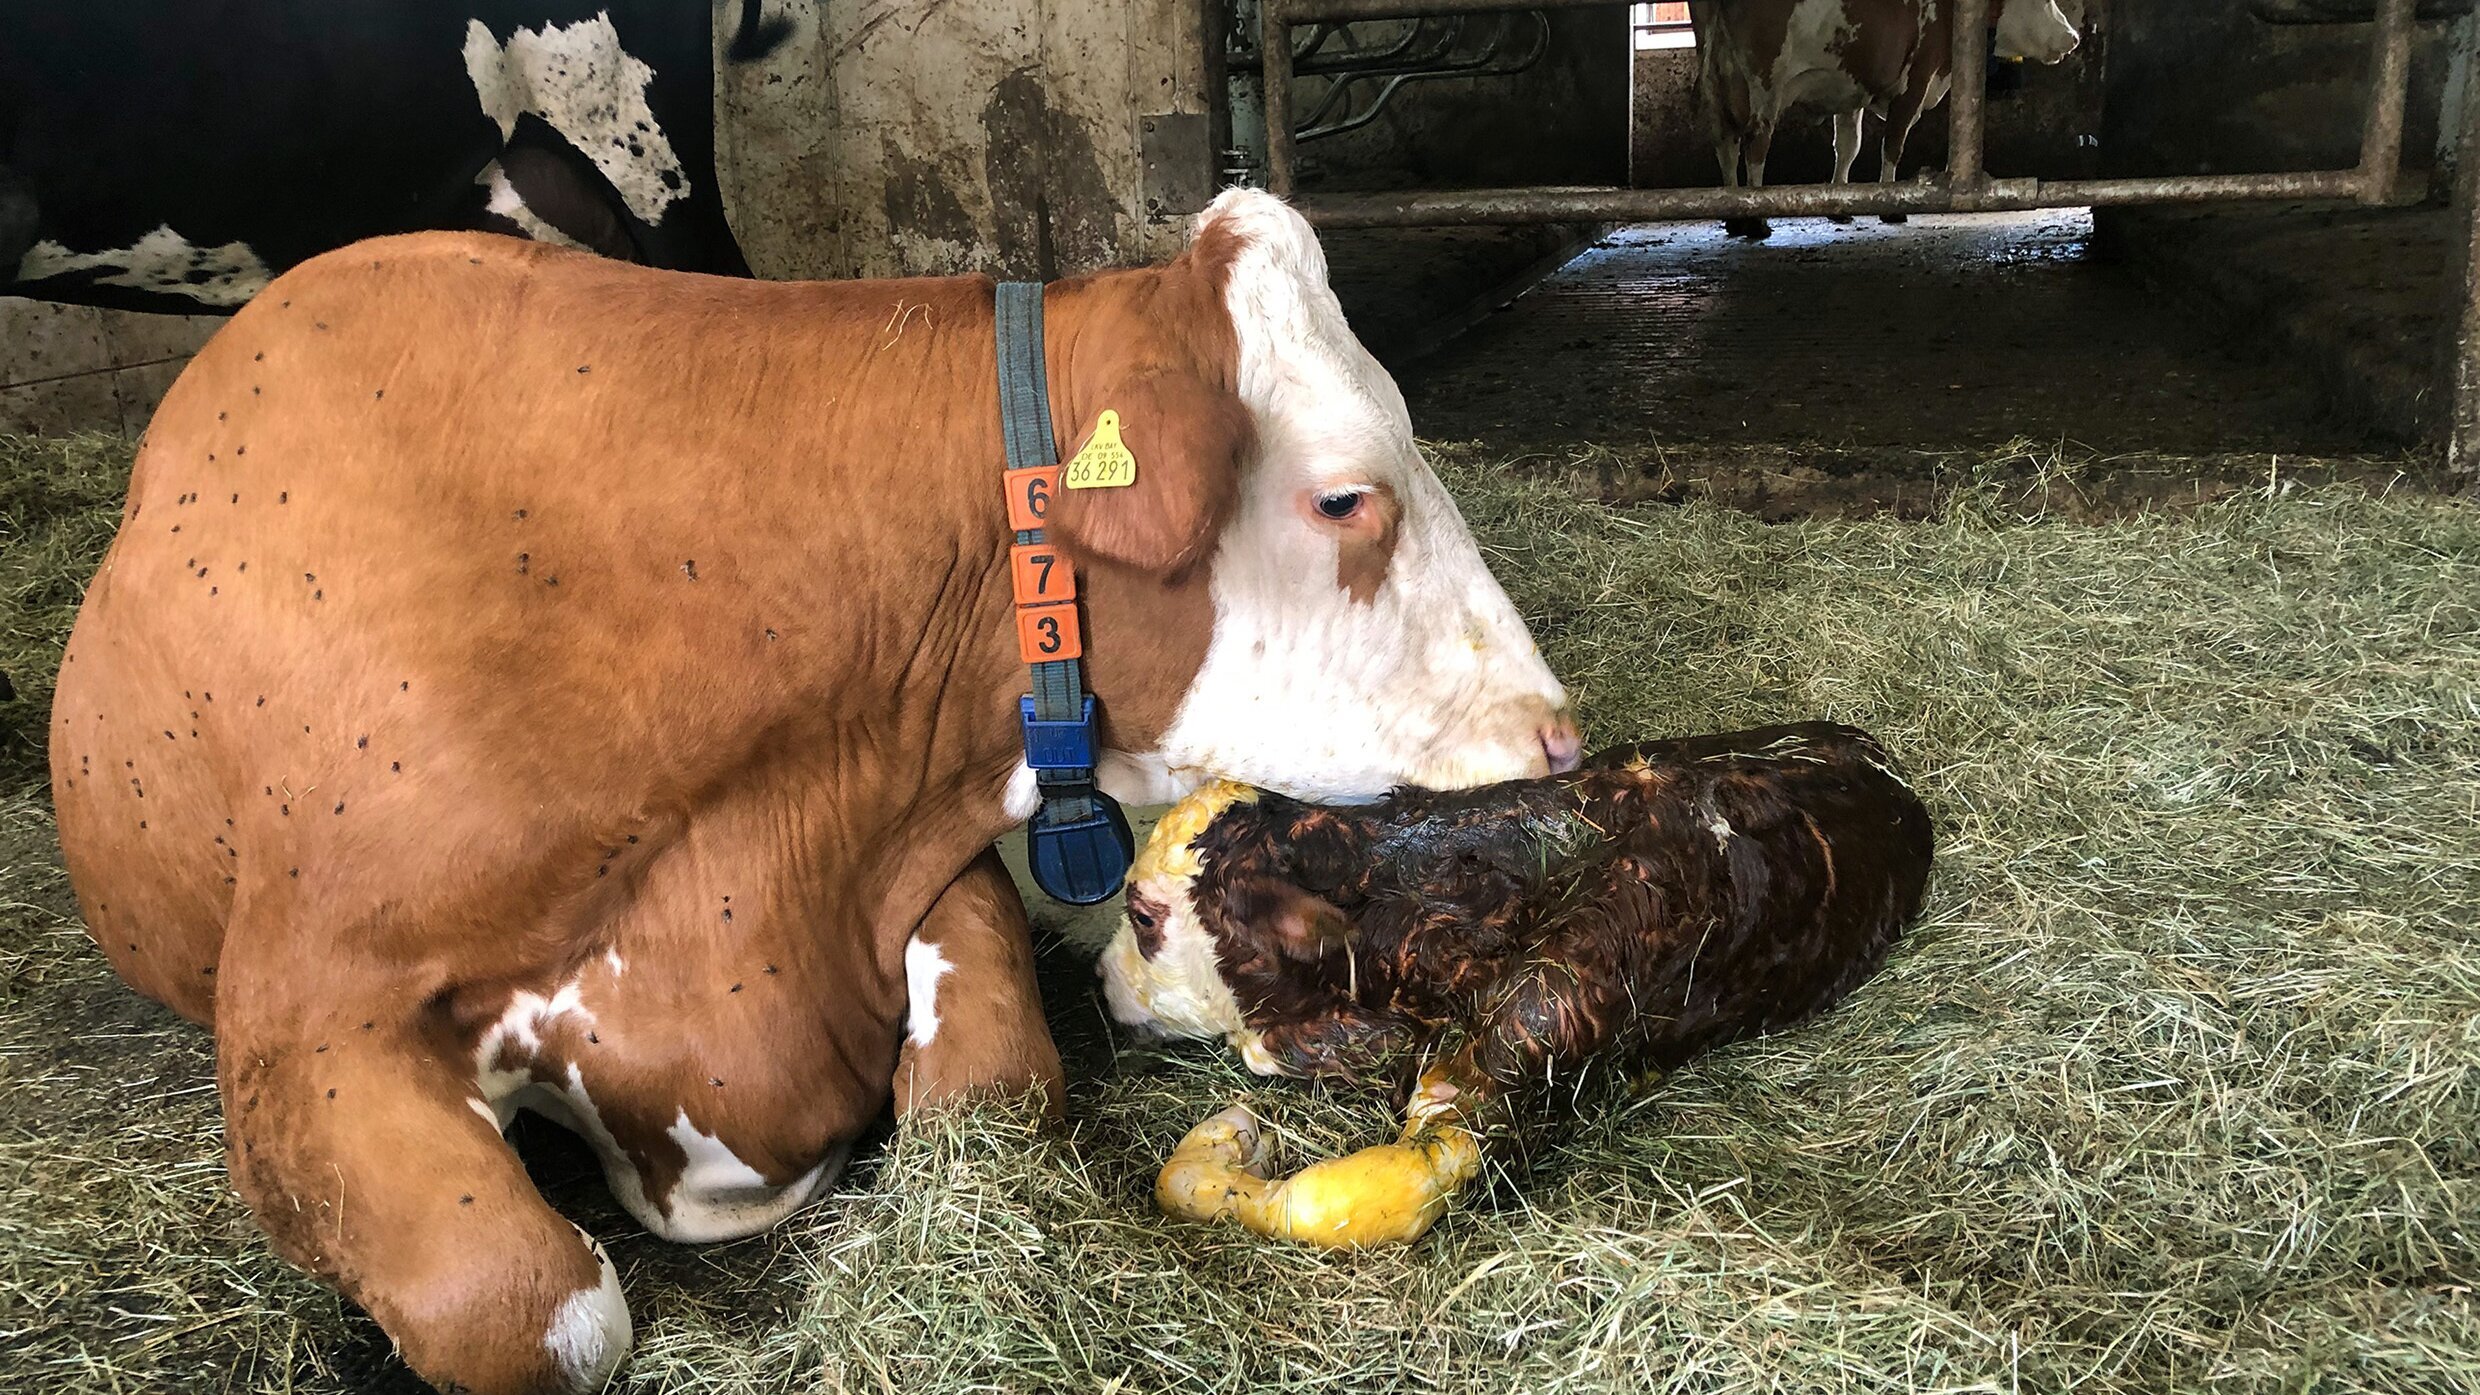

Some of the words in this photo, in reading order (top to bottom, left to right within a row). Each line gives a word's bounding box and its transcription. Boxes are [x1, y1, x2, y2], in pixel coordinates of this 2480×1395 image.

[1070, 460, 1091, 482] 36
[1095, 459, 1129, 481] 291
[1027, 478, 1050, 519] 6
[1030, 555, 1055, 595] 7
[1037, 616, 1062, 654] 3
